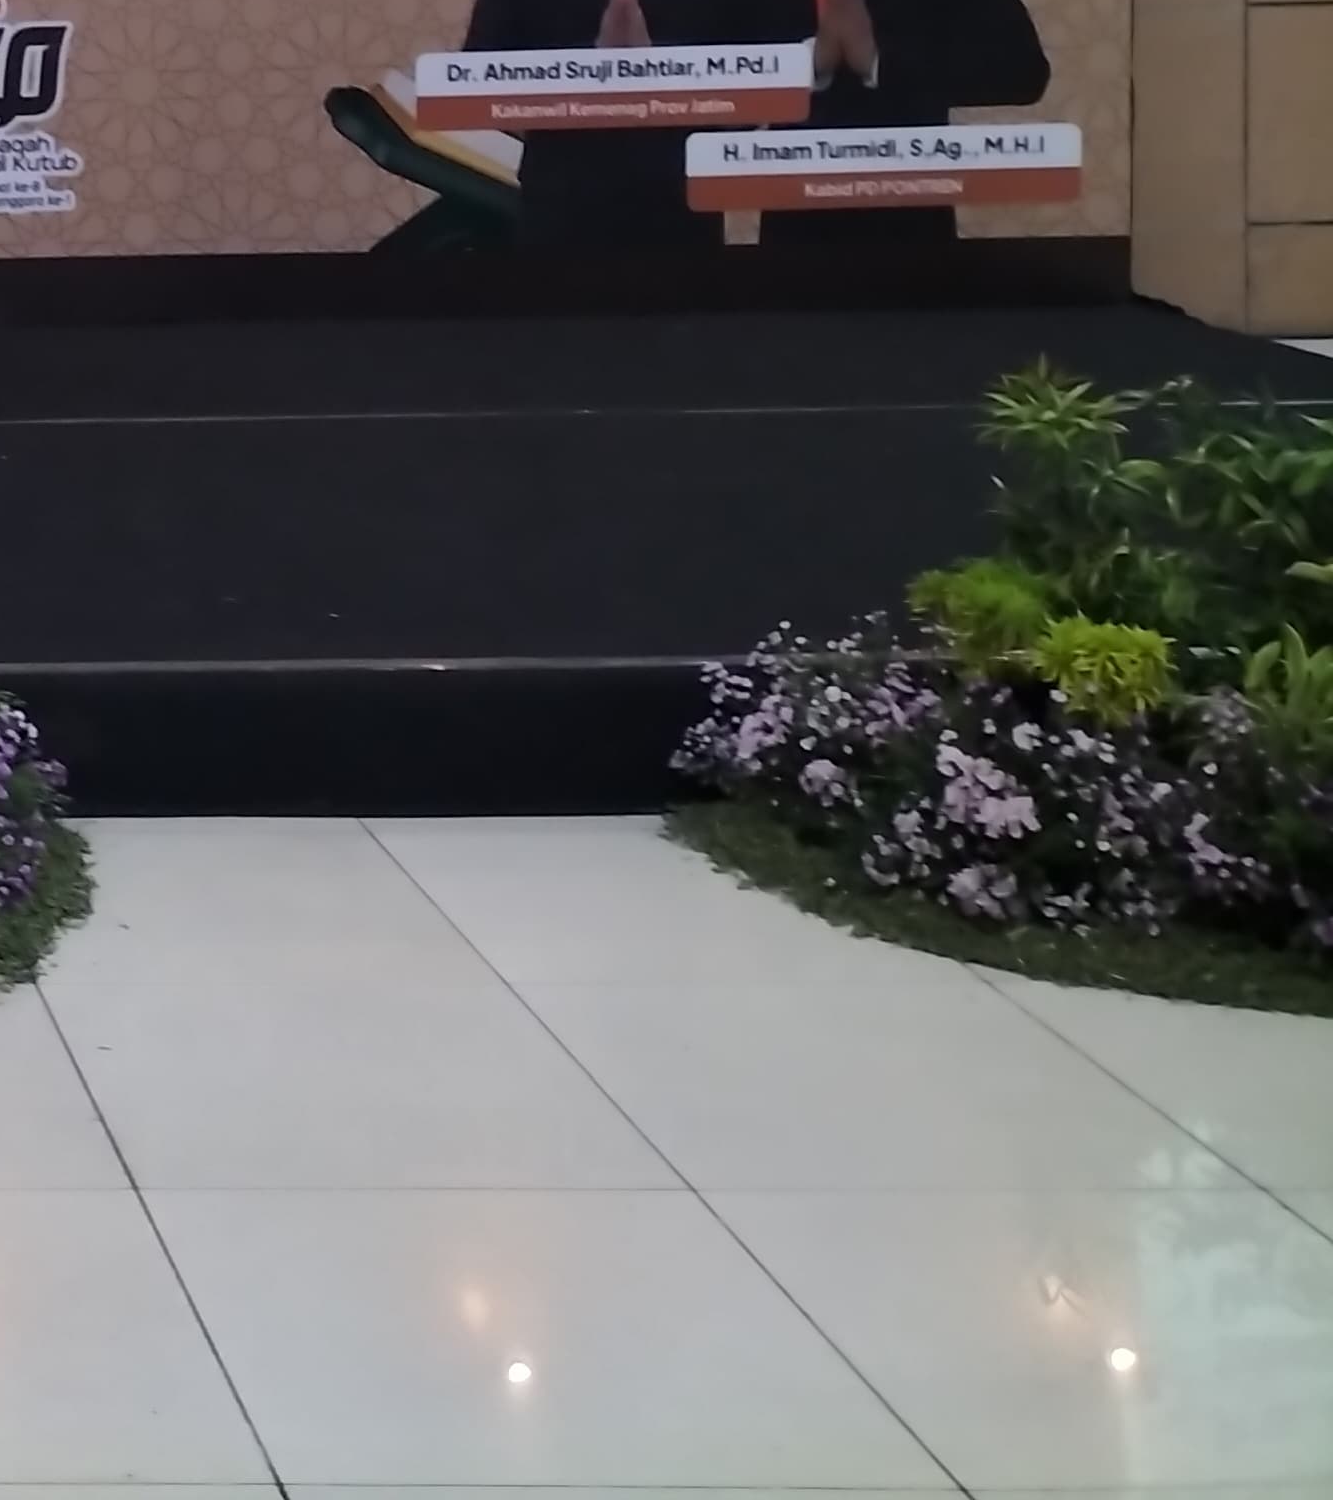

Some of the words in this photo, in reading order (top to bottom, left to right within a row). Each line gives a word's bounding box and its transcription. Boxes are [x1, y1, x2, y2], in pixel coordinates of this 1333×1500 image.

[447, 63, 477, 82] Dr.
[484, 61, 561, 81] Ahmad
[565, 59, 613, 83] Sruji
[617, 57, 701, 80] Bahtiar,
[723, 143, 747, 162] H.
[752, 141, 812, 160] Imam
[12, 153, 78, 172] Kutub
